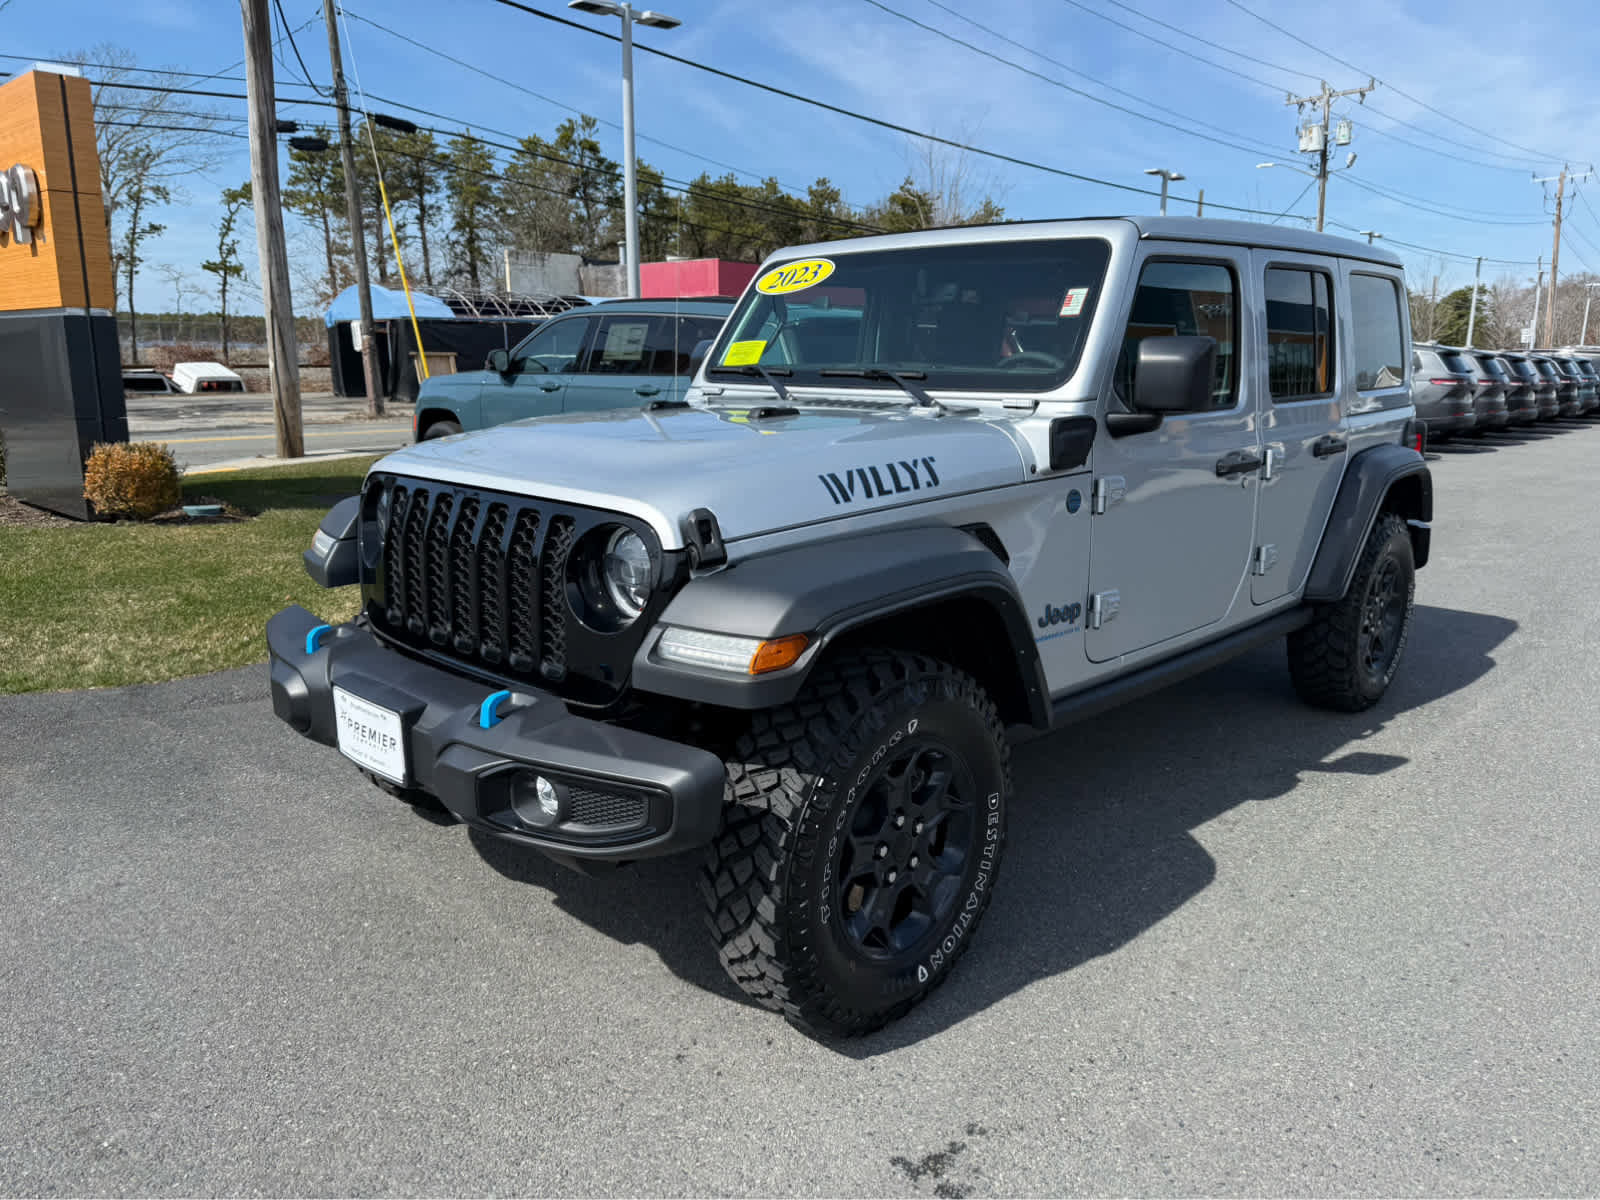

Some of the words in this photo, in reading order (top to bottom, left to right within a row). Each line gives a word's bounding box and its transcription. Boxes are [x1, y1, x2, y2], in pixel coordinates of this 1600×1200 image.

[767, 264, 823, 290] 2023
[818, 456, 939, 504] WILLYS
[1038, 602, 1081, 628] Jeep
[347, 718, 397, 751] PREMIER
[930, 793, 999, 970] DESTINATION
